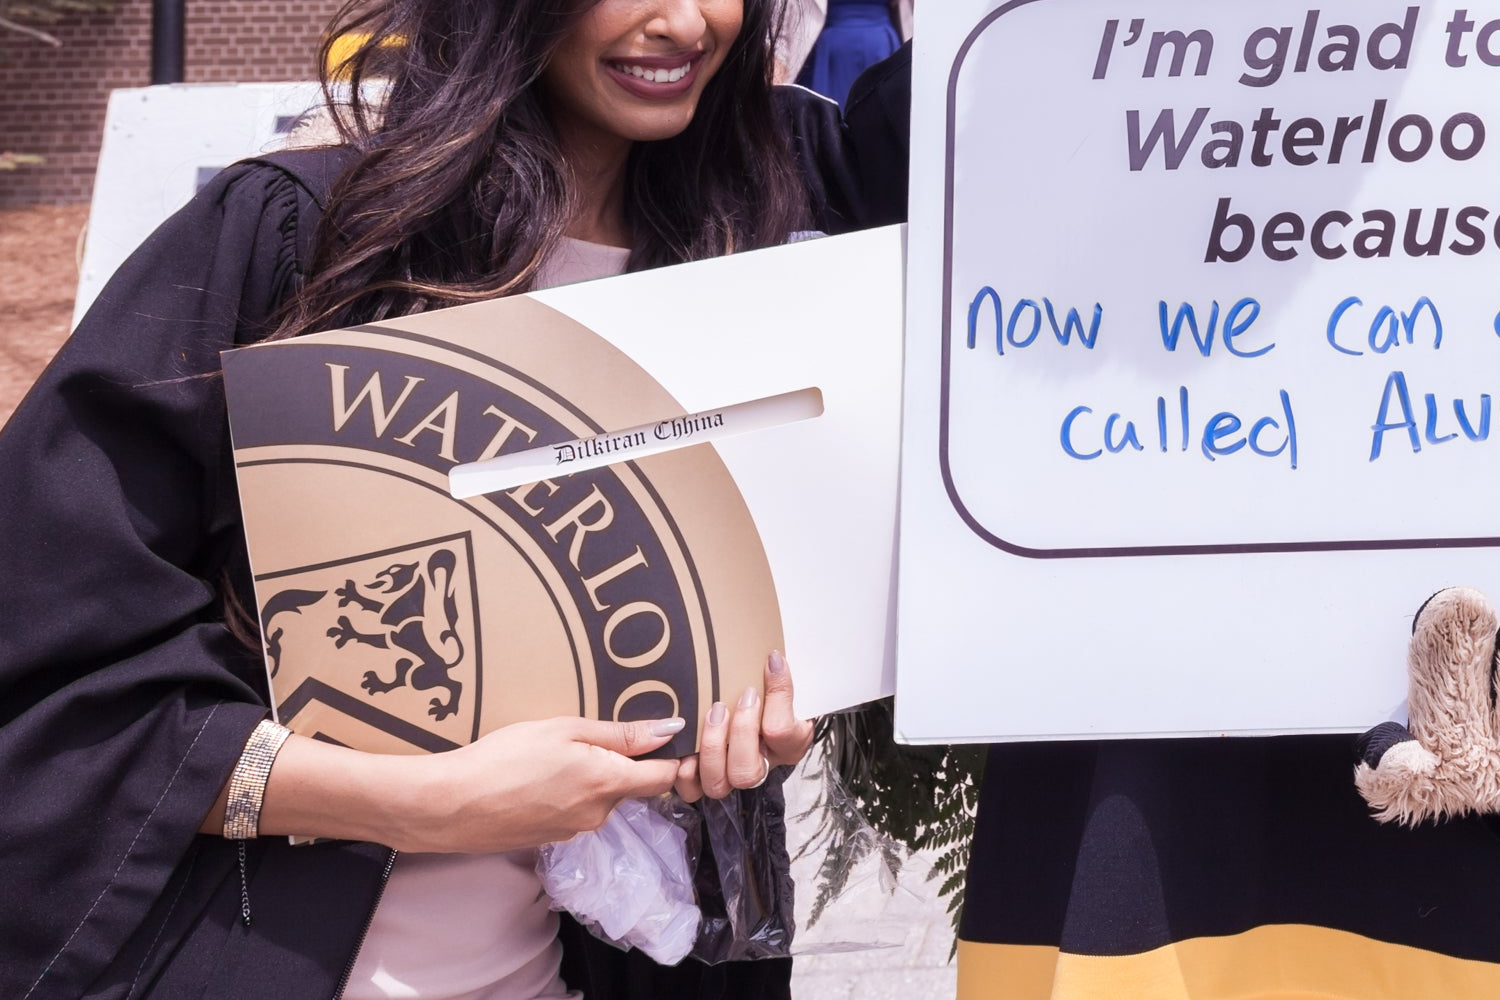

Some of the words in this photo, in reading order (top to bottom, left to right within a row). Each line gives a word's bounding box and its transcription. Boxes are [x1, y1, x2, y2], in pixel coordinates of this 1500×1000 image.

[1093, 19, 1213, 79] I'm
[1239, 6, 1420, 87] glad
[1126, 99, 1486, 172] Waterloo
[968, 286, 1104, 357] now
[1158, 297, 1276, 359] we
[1327, 296, 1444, 357] can
[1060, 386, 1298, 470] called
